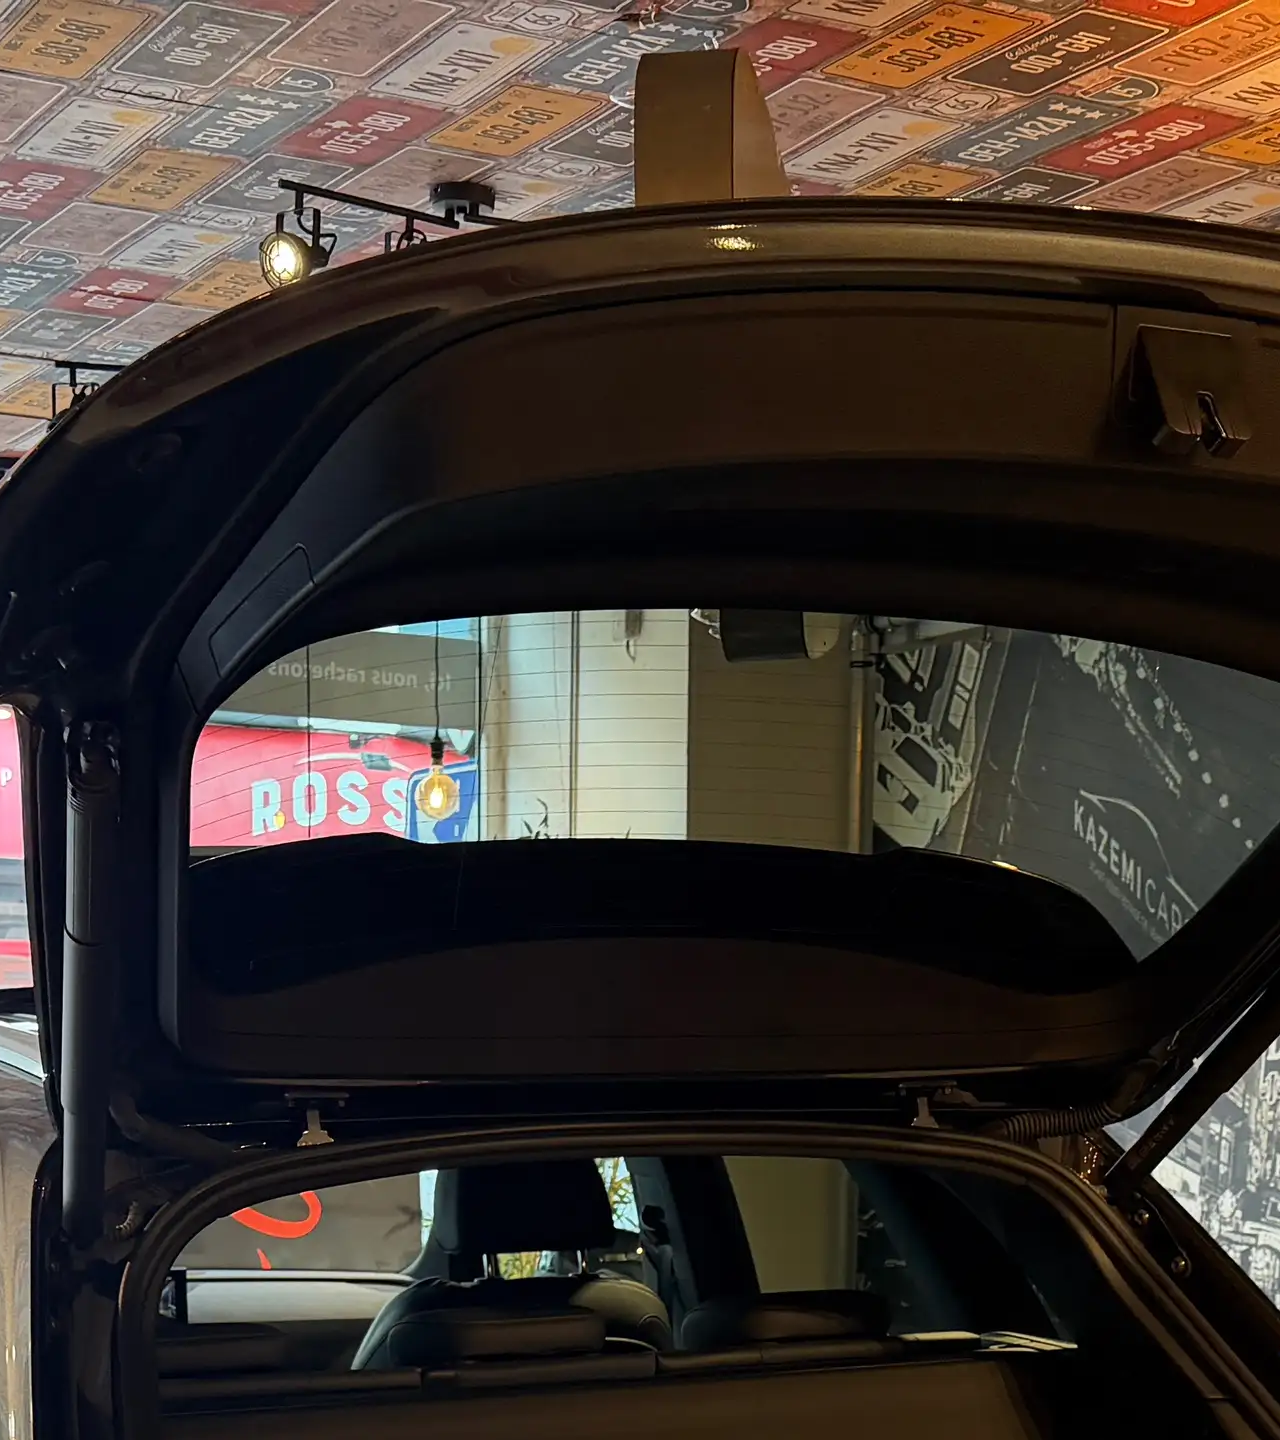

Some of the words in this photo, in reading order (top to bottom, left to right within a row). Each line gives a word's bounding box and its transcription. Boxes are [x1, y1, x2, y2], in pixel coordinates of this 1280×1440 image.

[858, 40, 893, 60] NEW
[894, 21, 934, 41] YORK
[1074, 799, 1142, 899] KAZEMI
